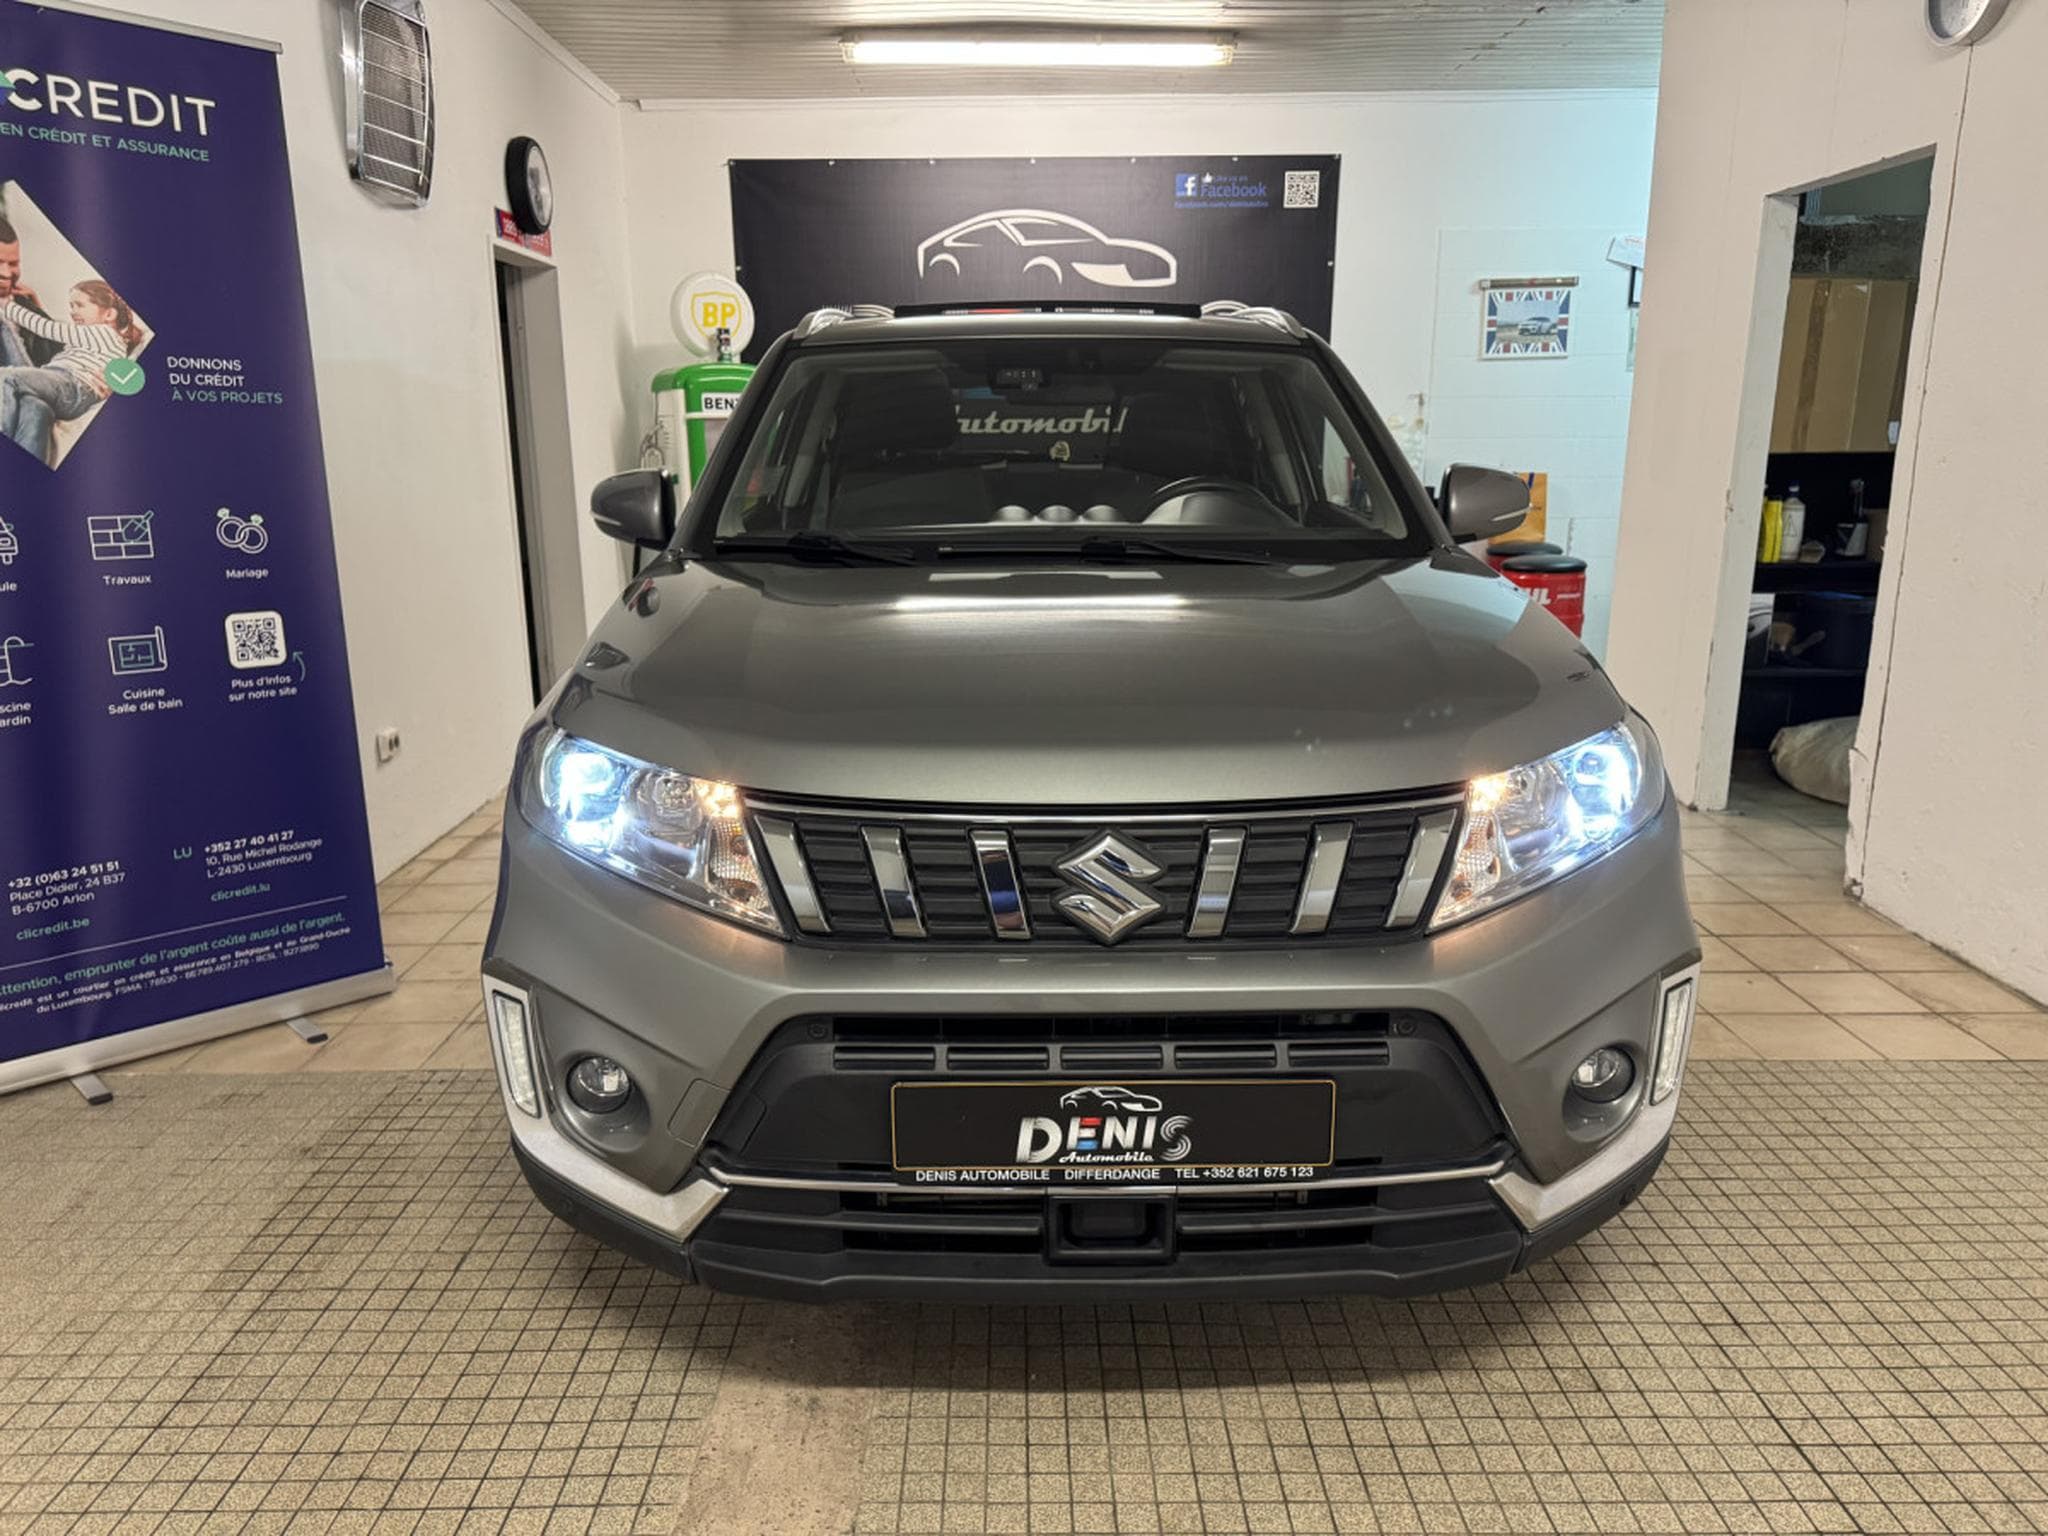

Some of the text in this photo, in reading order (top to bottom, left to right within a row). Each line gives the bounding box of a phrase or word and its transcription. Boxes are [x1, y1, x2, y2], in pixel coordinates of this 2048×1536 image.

[0, 122, 209, 162] EN CRÉDIT ET ASSURANCE
[1200, 181, 1267, 197] Facebook
[702, 302, 736, 328] BP
[167, 356, 242, 371] DONNONS
[169, 372, 245, 387] DU CRÉDIT
[172, 387, 283, 404] À VOS PROJETS
[704, 397, 738, 410] BEN
[955, 404, 1128, 434] utomobil
[103, 574, 152, 586] Travaux
[226, 568, 269, 581] Mariage
[231, 673, 292, 689] Plus d'infos
[123, 687, 165, 700] Cuisine
[228, 686, 298, 702] sur notre site
[108, 697, 184, 715] Salle de bain
[233, 838, 247, 849] 27
[250, 835, 265, 846] 40
[267, 833, 279, 843] 41
[281, 829, 294, 841] 27
[173, 846, 193, 860] LU
[222, 852, 243, 863] Rue
[245, 846, 278, 859] Michel
[207, 852, 312, 879] L-2430 Luxembourg
[8, 877, 32, 889] +32
[71, 866, 87, 877] 24
[90, 863, 104, 874] 51
[106, 860, 120, 872] 51
[9, 889, 43, 902] Place
[85, 877, 100, 889] 24
[103, 872, 126, 886] B37
[11, 899, 59, 916] B-6700
[16, 917, 90, 941] clicredit.be
[0, 977, 62, 996] ttention,
[64, 959, 136, 982] emprunter
[139, 952, 157, 965] de
[160, 941, 209, 960] l'argent
[250, 924, 280, 943] aussi
[281, 920, 298, 934] de
[1016, 1115, 1193, 1163] DENIS
[1059, 1151, 1155, 1164] Automobile
[915, 1166, 1314, 1182] DENIS AUTOMOBILE DIFFERDANGE TEL +352 621 675 123
